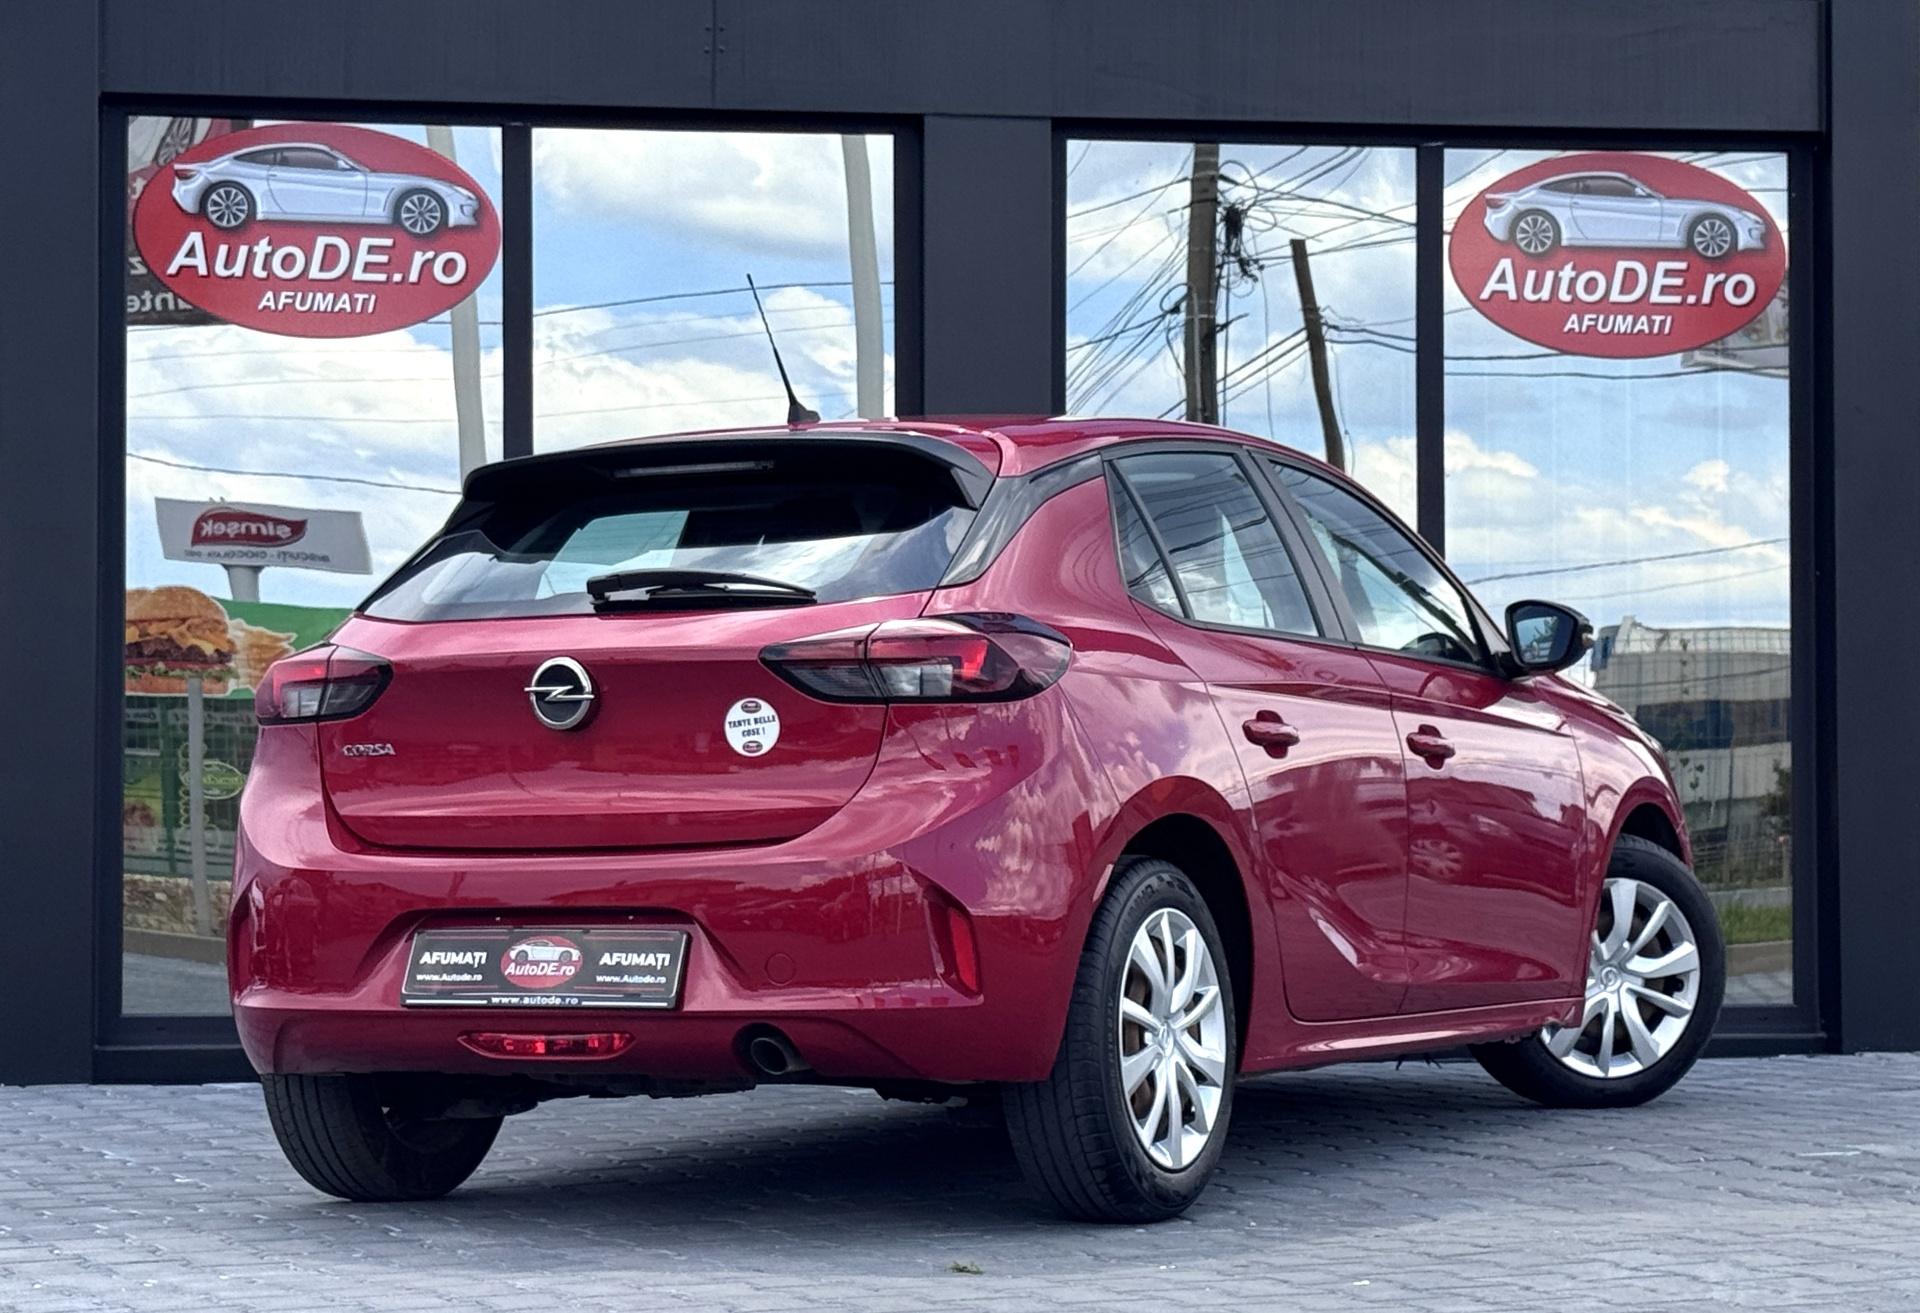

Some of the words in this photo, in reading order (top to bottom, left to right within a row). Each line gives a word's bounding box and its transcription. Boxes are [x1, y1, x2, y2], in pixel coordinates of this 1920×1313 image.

[166, 230, 468, 285] AutoDE.ro
[1479, 257, 1757, 307] AutoDE.ro
[258, 290, 377, 314] AFUMATI
[1563, 313, 1672, 336] AFUMATI
[728, 718, 751, 729] TANTE
[342, 743, 396, 757] CORSA
[504, 962, 576, 976] AutoDE.ro
[491, 996, 579, 1005] www.autode.ro
